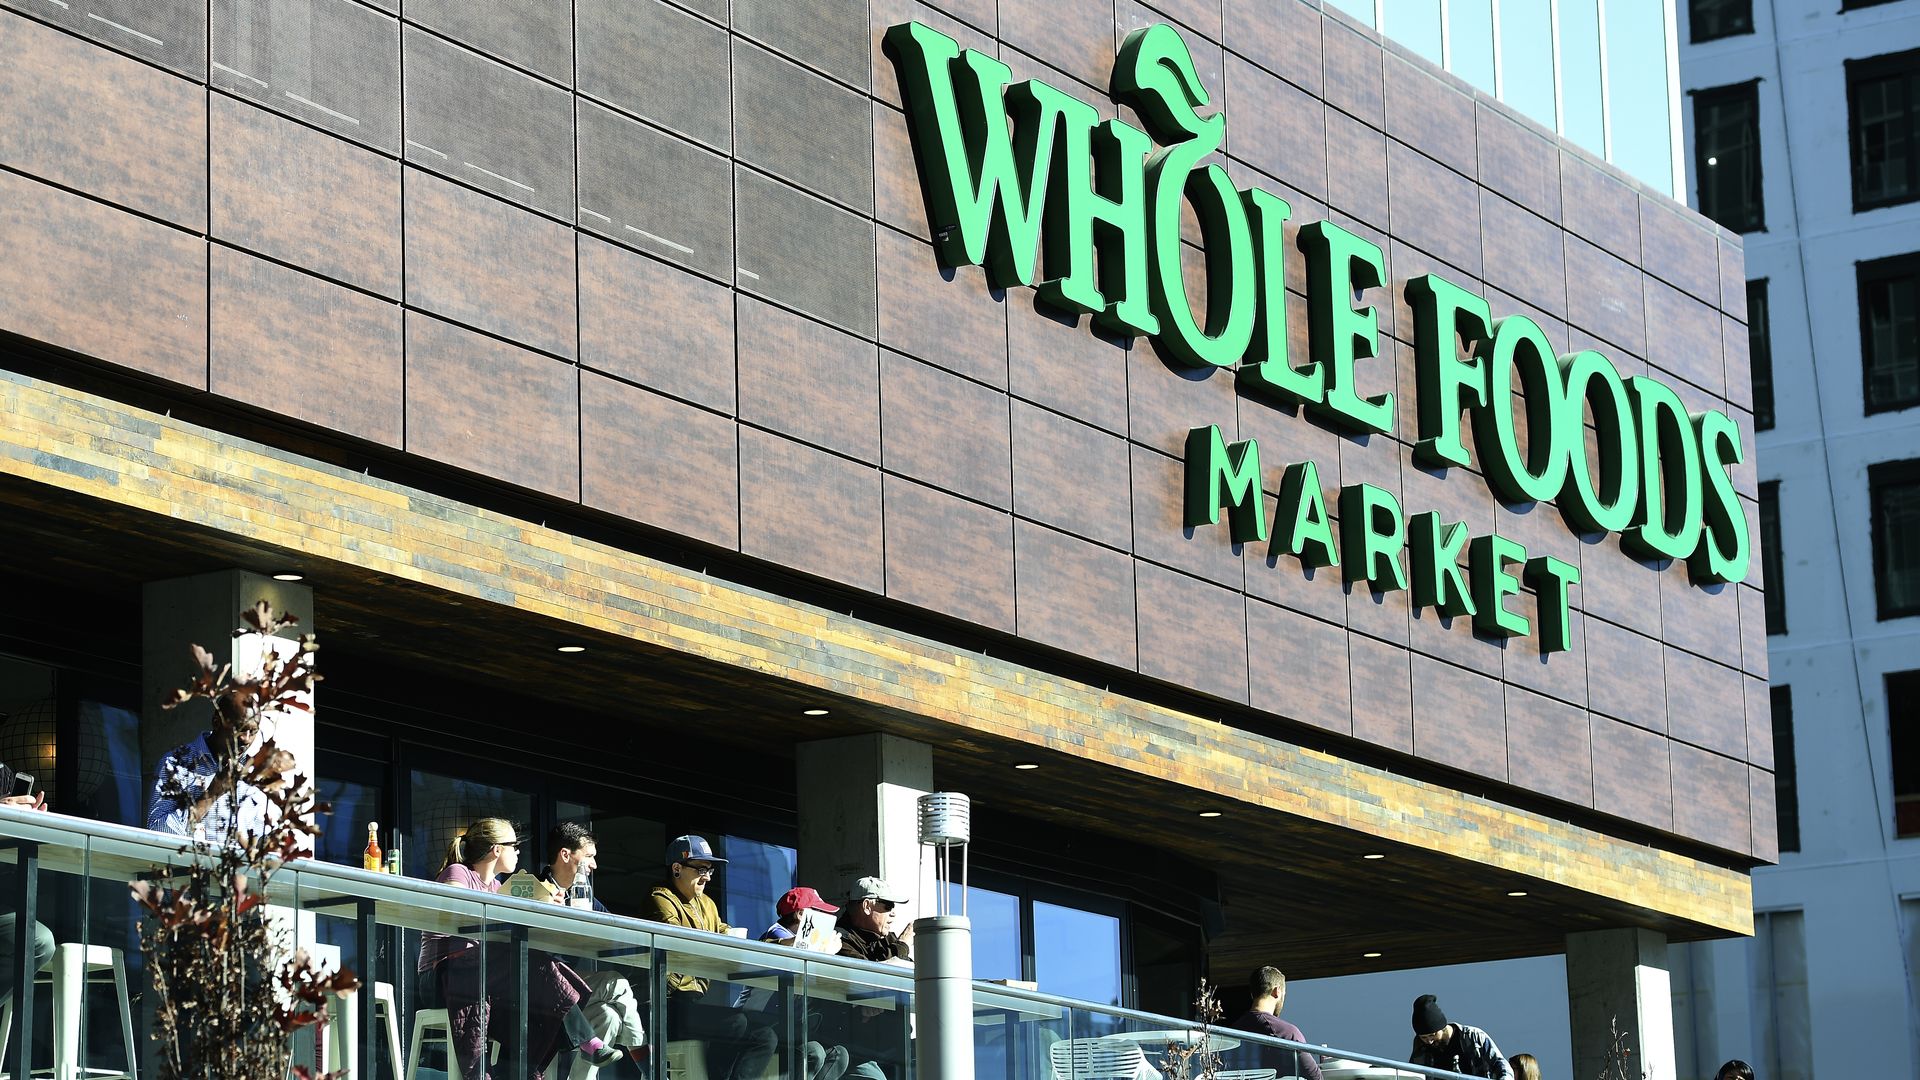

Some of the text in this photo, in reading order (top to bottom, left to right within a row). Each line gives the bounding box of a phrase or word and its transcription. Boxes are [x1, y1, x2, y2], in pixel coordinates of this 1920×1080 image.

[887, 21, 1750, 582] WHOLE FOODS
[1190, 424, 1581, 651] MARKET
